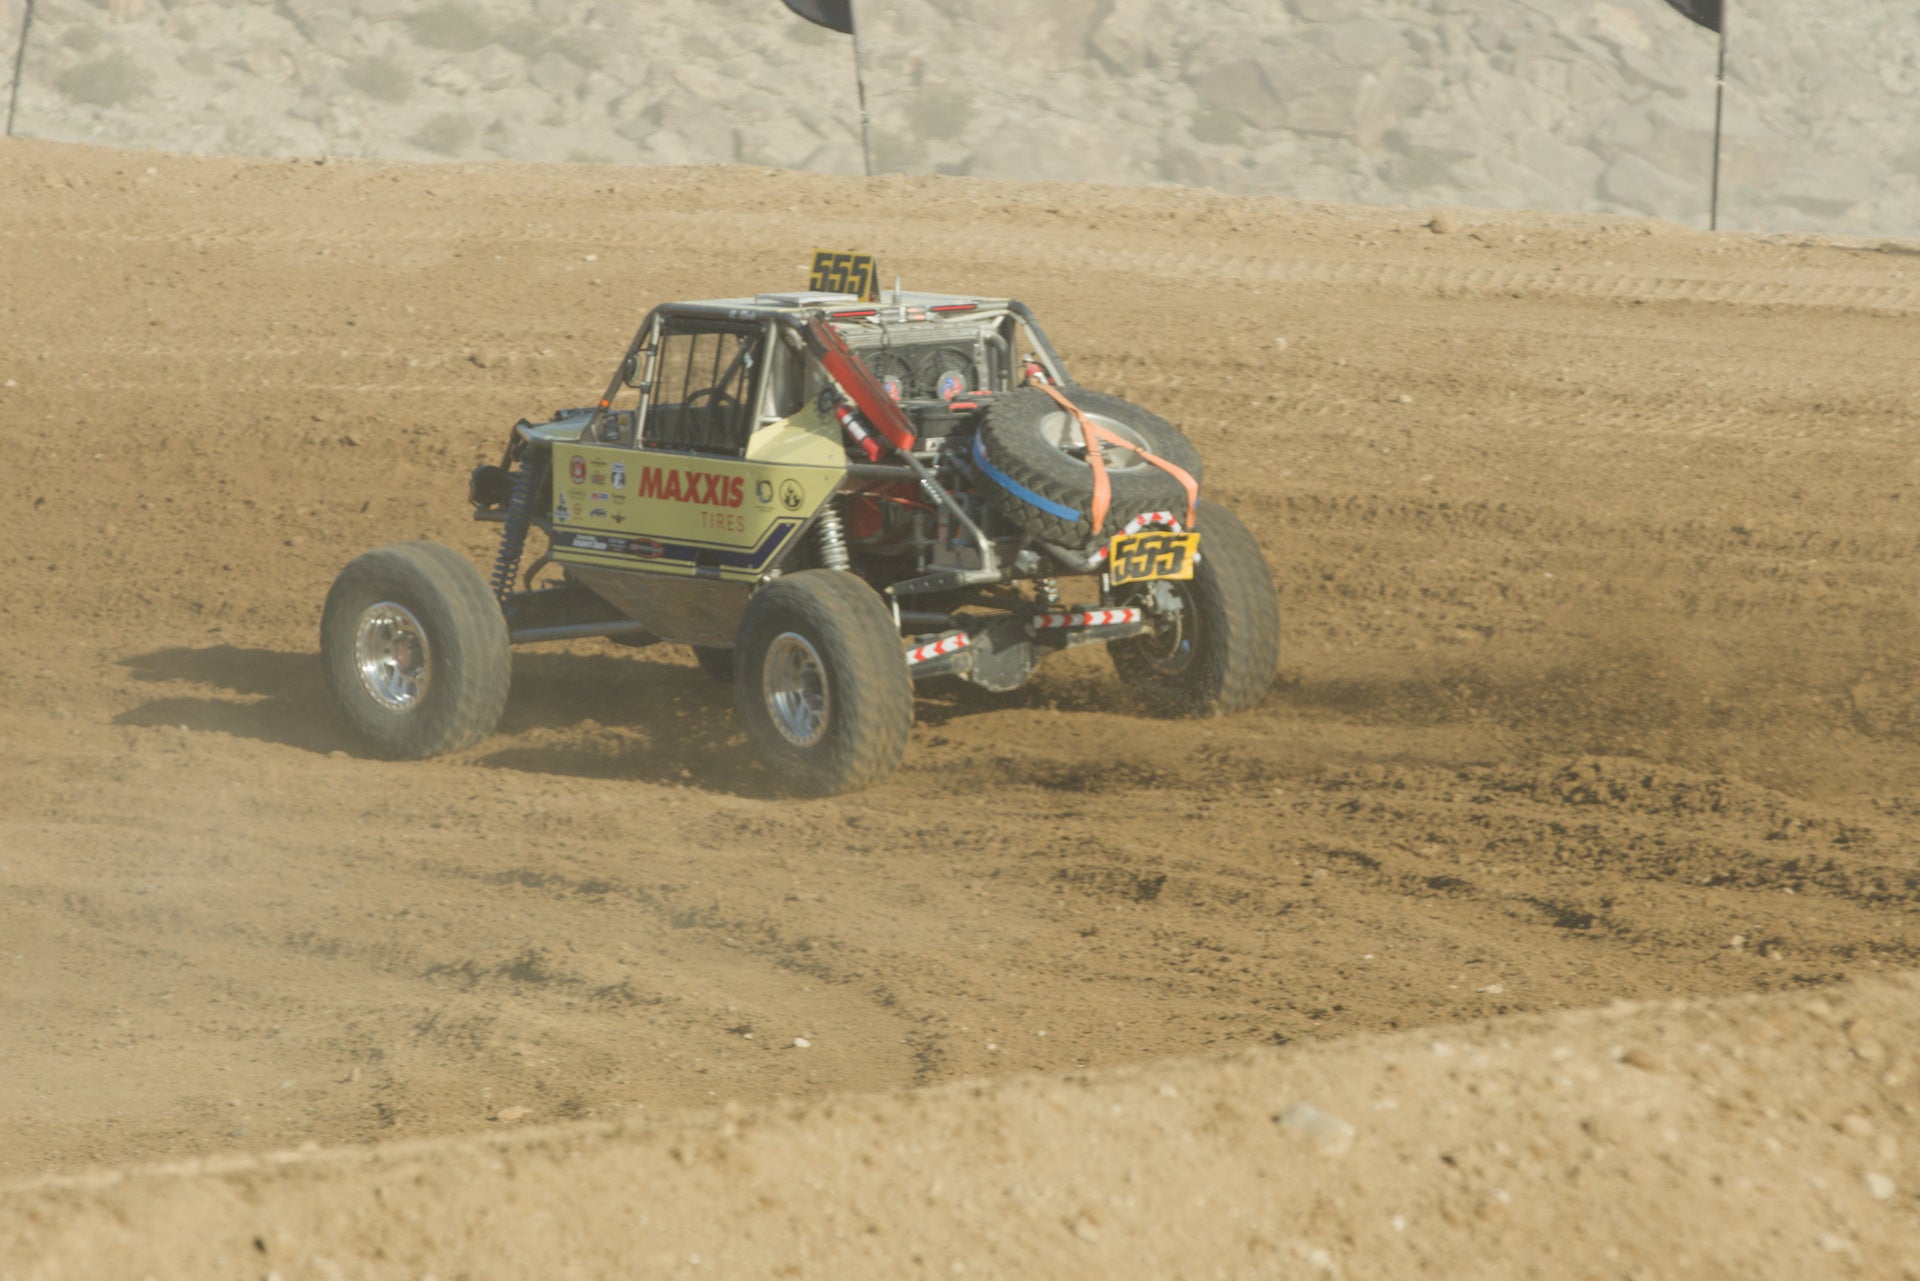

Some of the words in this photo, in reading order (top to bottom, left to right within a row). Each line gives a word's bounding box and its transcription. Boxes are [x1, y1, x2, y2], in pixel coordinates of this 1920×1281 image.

[809, 252, 871, 297] 555
[638, 466, 745, 508] MAXXIS
[700, 511, 745, 533] TIRES
[1115, 535, 1189, 582] 555
